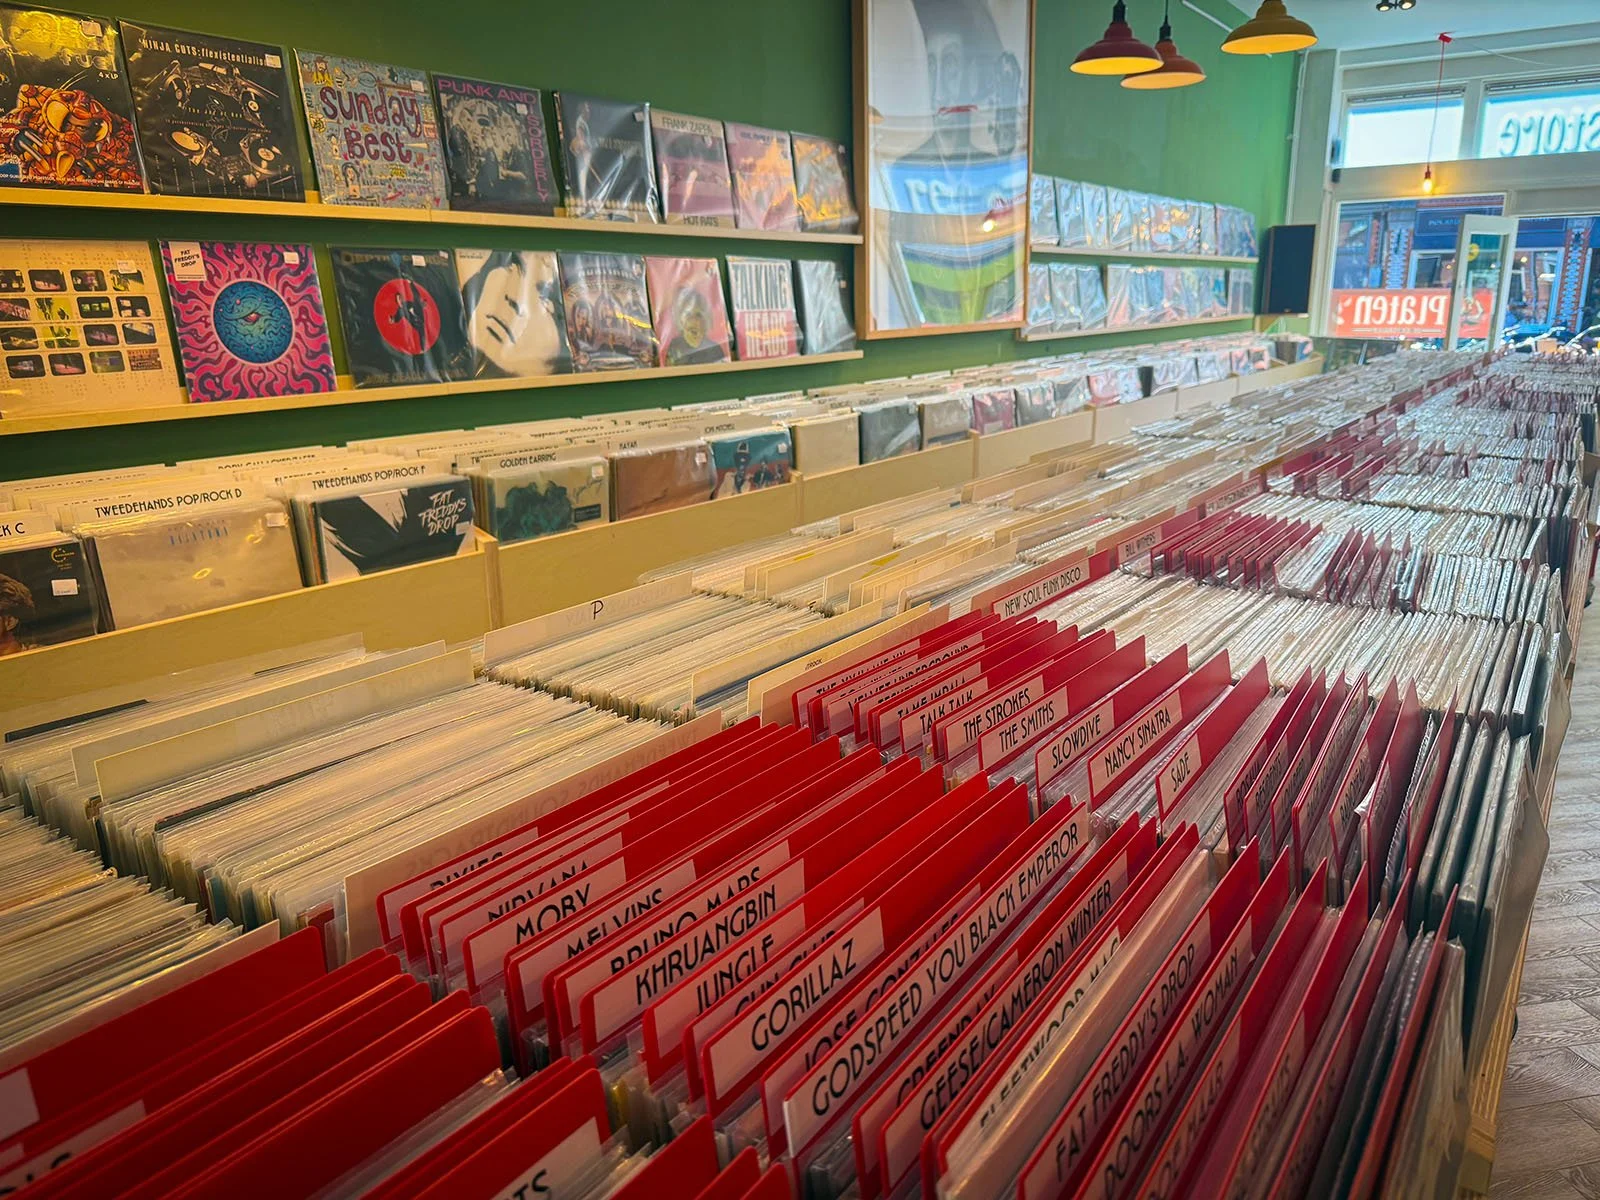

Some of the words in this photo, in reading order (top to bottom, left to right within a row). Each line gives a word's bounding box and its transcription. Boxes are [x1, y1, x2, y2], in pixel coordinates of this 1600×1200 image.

[142, 40, 171, 52] NINJA
[174, 43, 267, 66] CUTS:flexistentialis
[438, 78, 493, 97] PUNK
[496, 88, 537, 107] AND
[312, 473, 373, 491] TWEEDEHANDS
[374, 466, 417, 482] POP/ROCK
[500, 457, 529, 469] GOLDEN
[529, 452, 557, 465] EARRING
[95, 497, 174, 519] TWEEDEHANDS
[177, 490, 234, 508] POP/ROCK
[235, 488, 242, 500] D
[418, 498, 467, 527] FREDDYS
[430, 488, 455, 507] FAT
[427, 515, 460, 537] DROP
[591, 600, 604, 620] P
[1004, 599, 1021, 618] NEW
[1023, 587, 1040, 609] SOUL
[1042, 577, 1061, 600] FUNK
[1060, 566, 1081, 591] DISCO
[964, 718, 982, 743] THE
[985, 687, 1031, 727] STROKES
[999, 722, 1018, 752] THE
[1021, 700, 1055, 739] SMITHS
[1052, 714, 1101, 769] SLOWDIVE
[1105, 736, 1136, 778] NANCY
[1137, 706, 1171, 749] SINATRA
[1170, 751, 1191, 793] SADE
[636, 884, 776, 1005] KHRUANGBIN
[811, 981, 922, 1117] GODSPEED
[926, 933, 966, 995] YOU
[970, 886, 1015, 953] BLACK
[1018, 822, 1078, 903] EMPEROR
[752, 938, 856, 1051] GORILLAZ
[920, 934, 1065, 1130] GEESE/CAMERON
[1067, 879, 1112, 946] WINTER
[1191, 947, 1239, 1043] WOMAN
[1056, 1105, 1089, 1182] FAT
[1091, 998, 1158, 1126] FREDDY'S
[1161, 943, 1195, 1015] DROP
